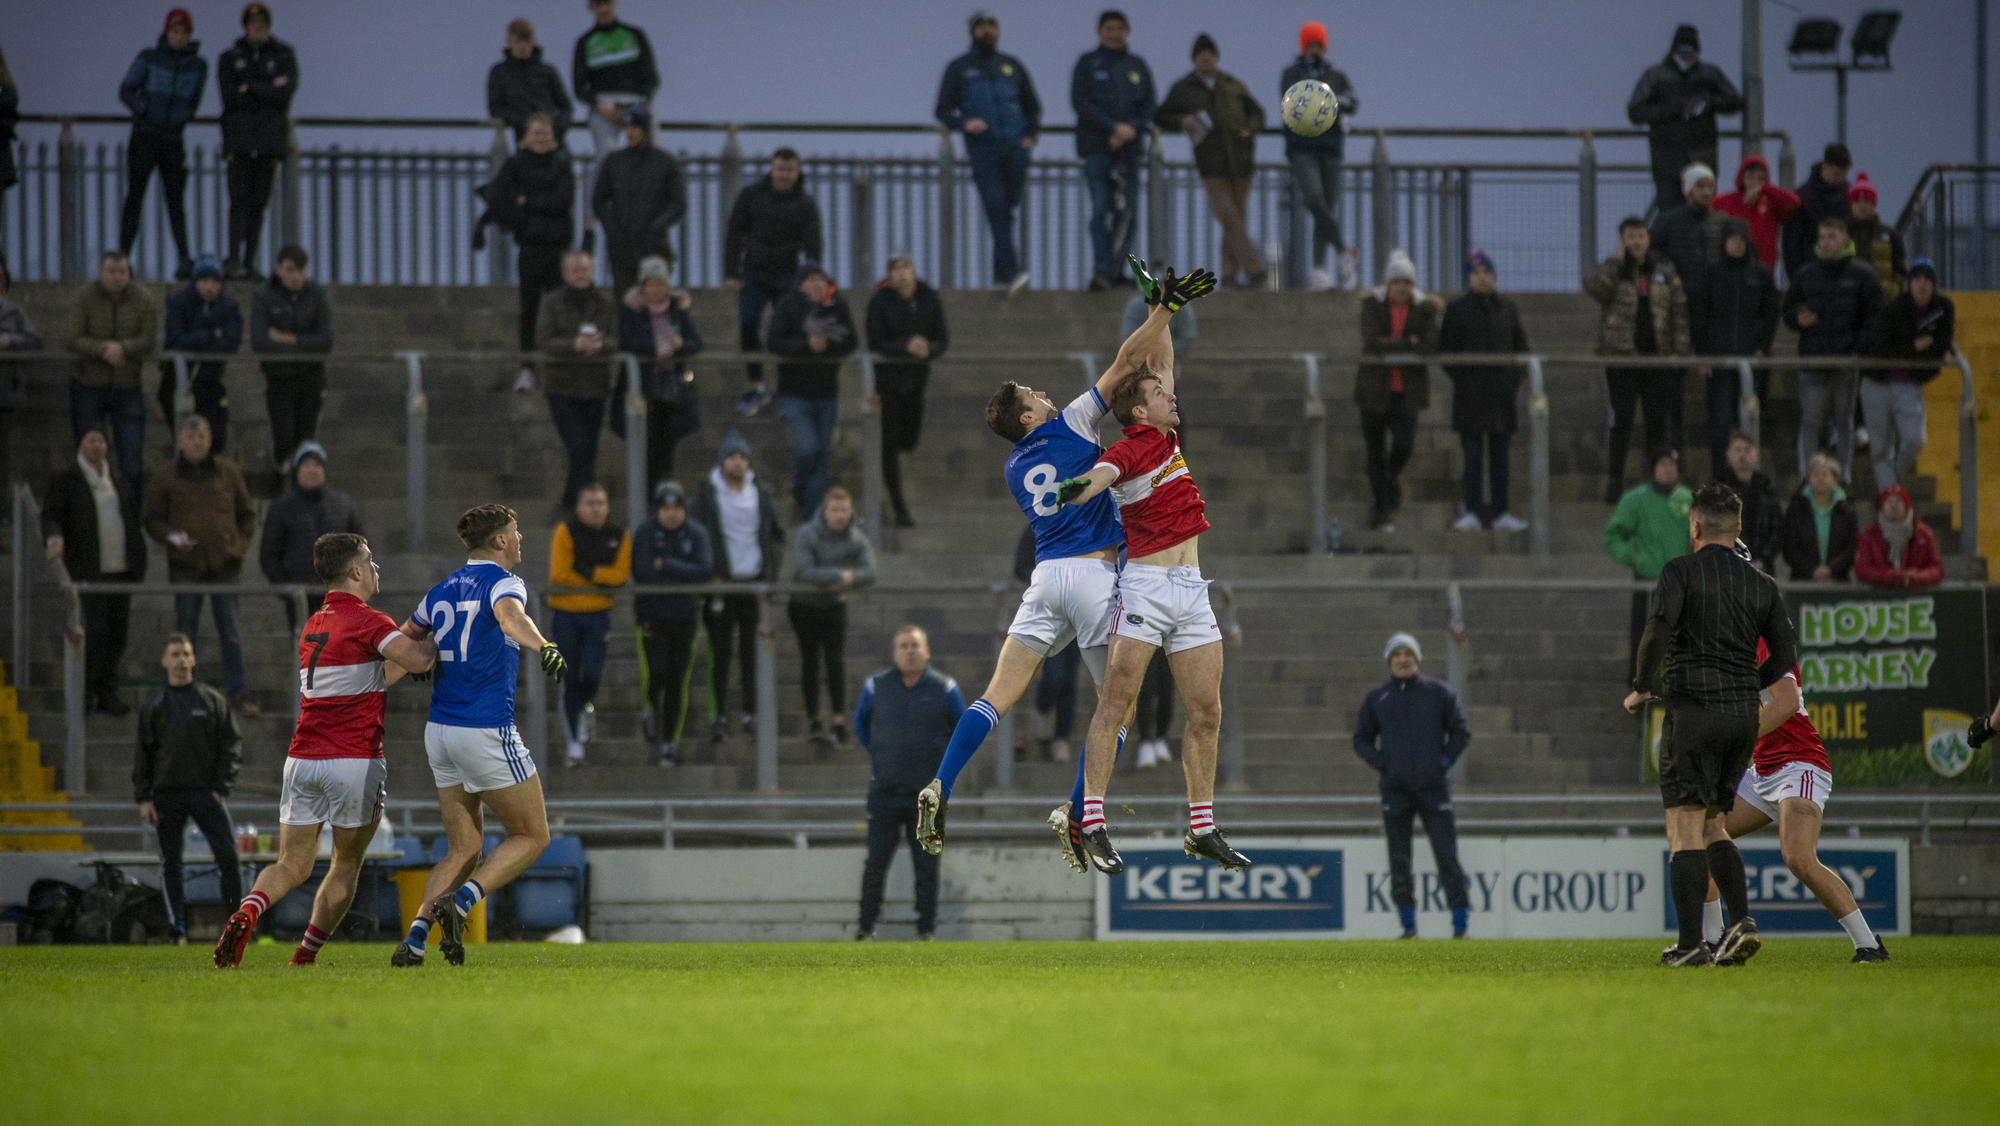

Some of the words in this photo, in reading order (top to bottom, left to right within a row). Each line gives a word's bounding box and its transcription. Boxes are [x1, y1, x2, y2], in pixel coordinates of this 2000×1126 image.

[1023, 463, 1065, 517] 8
[431, 600, 481, 662] 27
[1801, 597, 1937, 645] HOUSE
[304, 632, 329, 691] 7
[1800, 649, 1937, 691] ARNEY
[1804, 702, 1868, 740] AA.IE
[1125, 865, 1323, 900] KERRY
[1364, 871, 1500, 913] KRY
[1511, 870, 1647, 913] GROUP
[1744, 865, 1878, 901] ERY
